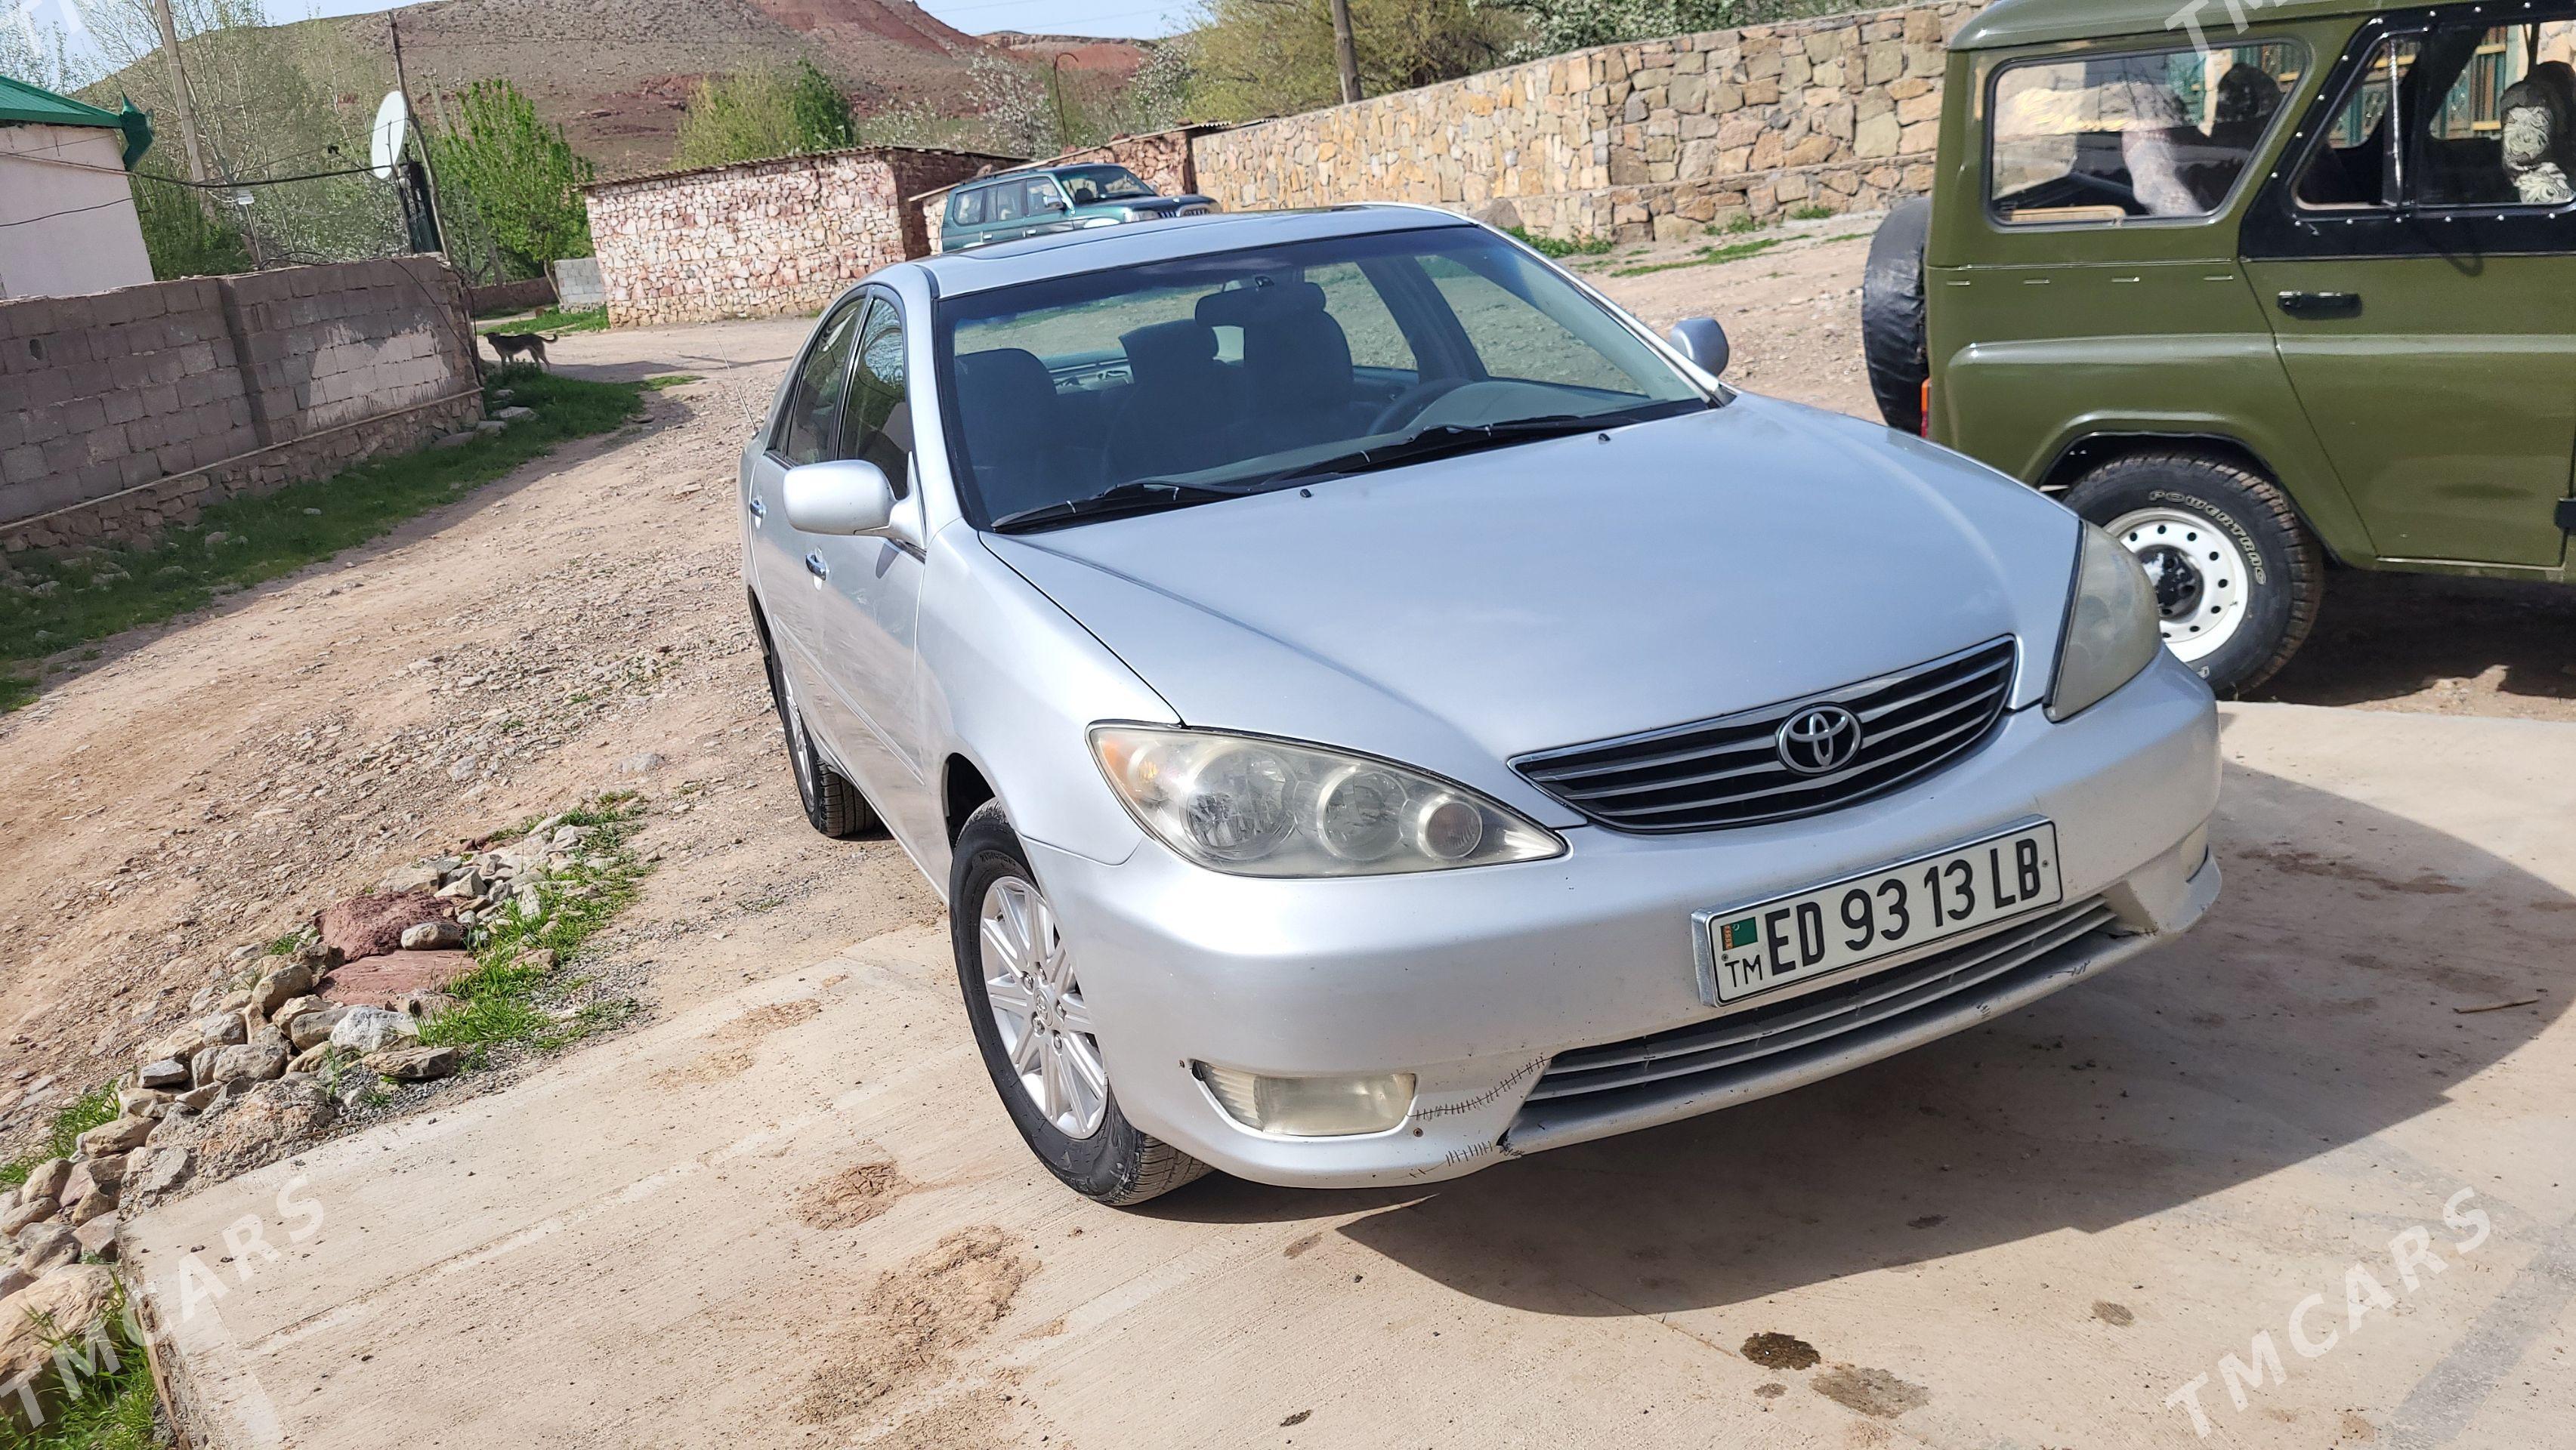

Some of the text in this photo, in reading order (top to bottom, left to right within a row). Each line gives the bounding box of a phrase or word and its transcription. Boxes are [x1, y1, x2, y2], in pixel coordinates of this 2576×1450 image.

[1765, 838, 2042, 976] ED 93 13 LB
[1725, 955, 1763, 988] TM
